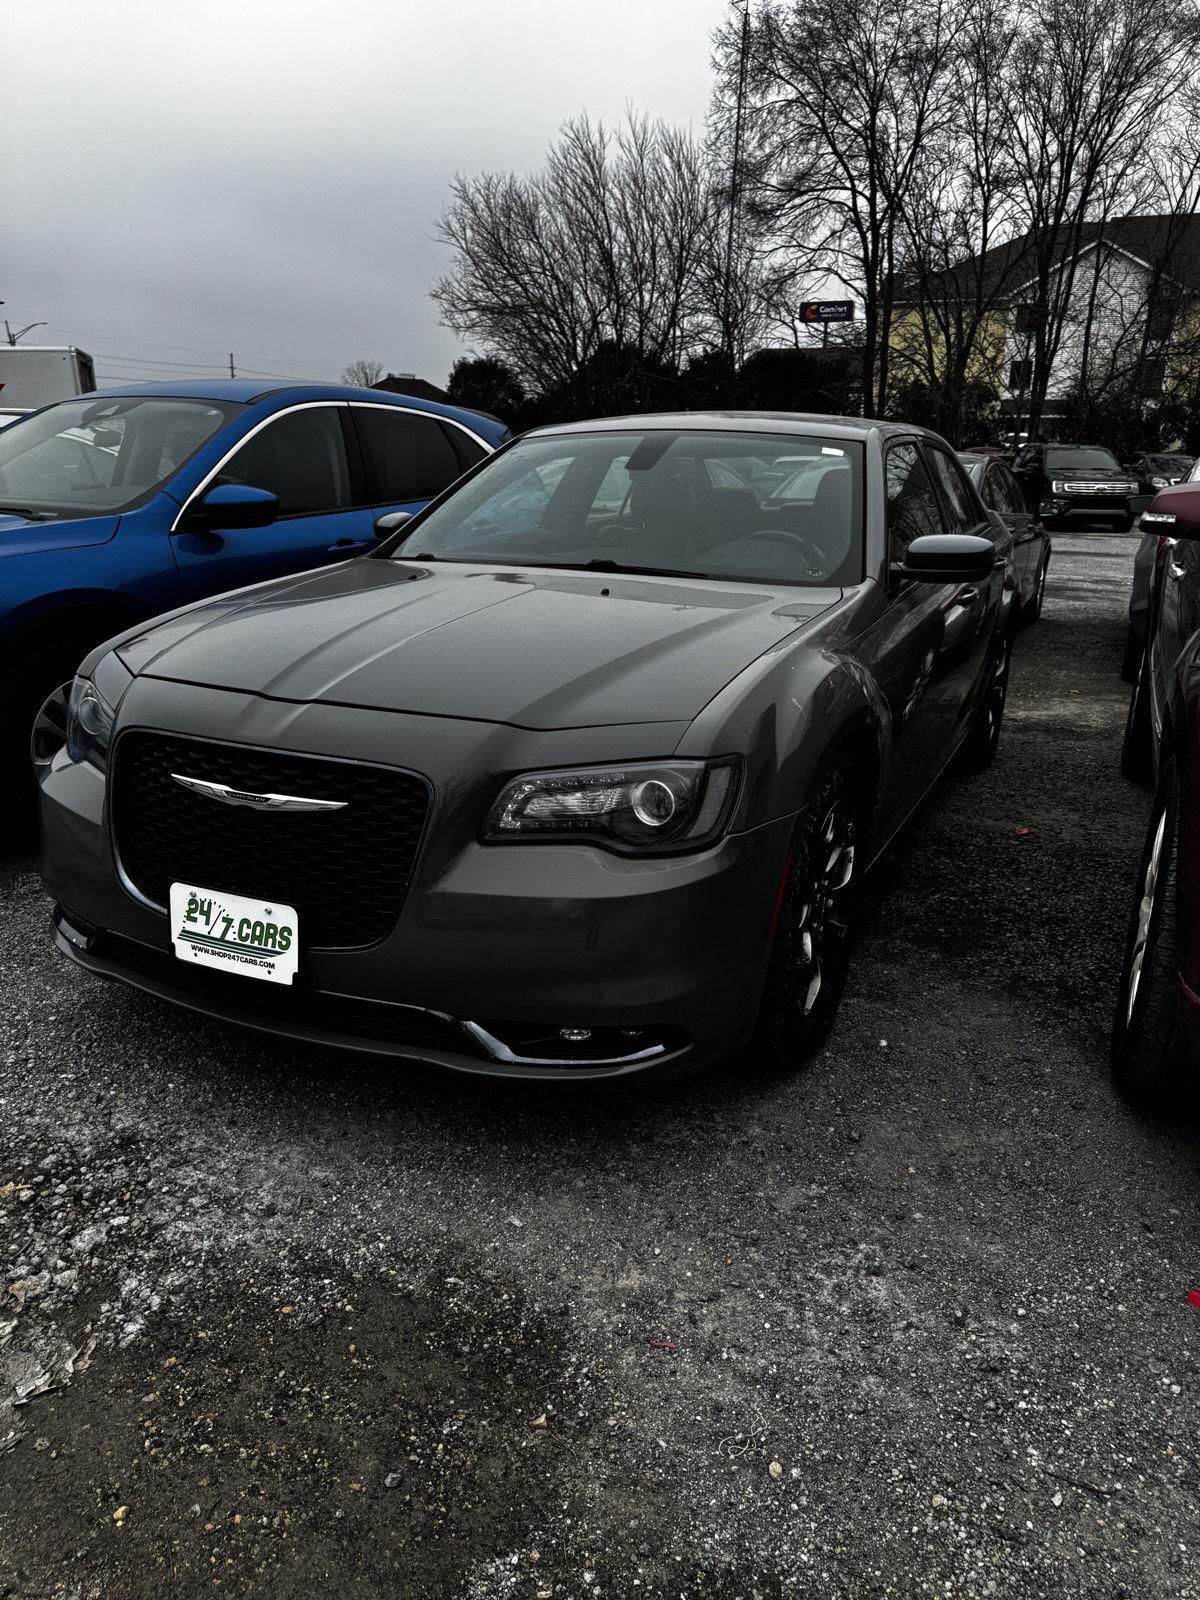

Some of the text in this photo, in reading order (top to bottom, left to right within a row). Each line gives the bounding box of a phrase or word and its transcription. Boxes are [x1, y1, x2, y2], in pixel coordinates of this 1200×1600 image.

[819, 305, 847, 313] Comfort
[186, 898, 293, 951] 24/7 CARS
[190, 944, 276, 970] WWW.SHOP247CARS.COM
